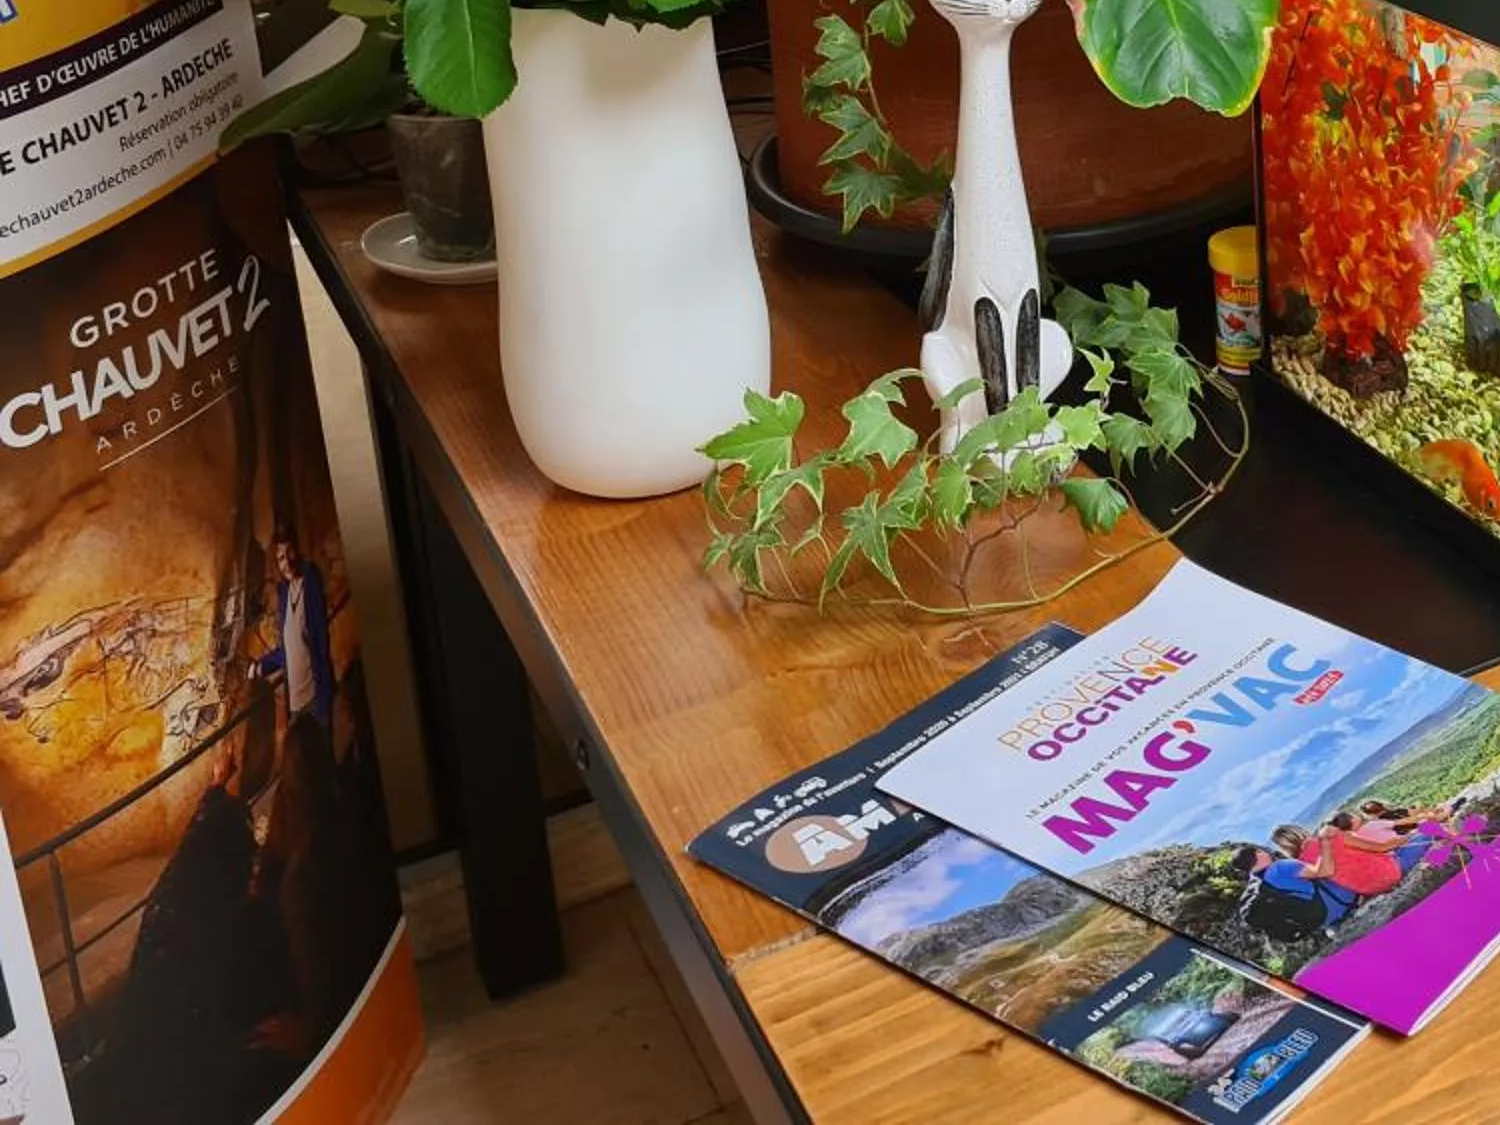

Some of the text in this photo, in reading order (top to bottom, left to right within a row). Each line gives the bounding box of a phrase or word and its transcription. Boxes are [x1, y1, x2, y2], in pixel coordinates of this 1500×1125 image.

[119, 34, 140, 56] DE
[21, 97, 129, 165] CHAUVET
[133, 91, 148, 114] 2
[161, 37, 233, 100] ARDECHE
[70, 248, 220, 348] GROTTE
[0, 255, 271, 449] CHAUVET 2
[96, 354, 240, 454] ARDÈCHE
[999, 637, 1173, 751] PROVENCE
[1040, 772, 1092, 809] MAGAZINE
[1088, 971, 1155, 1023] LE RAID BLEU
